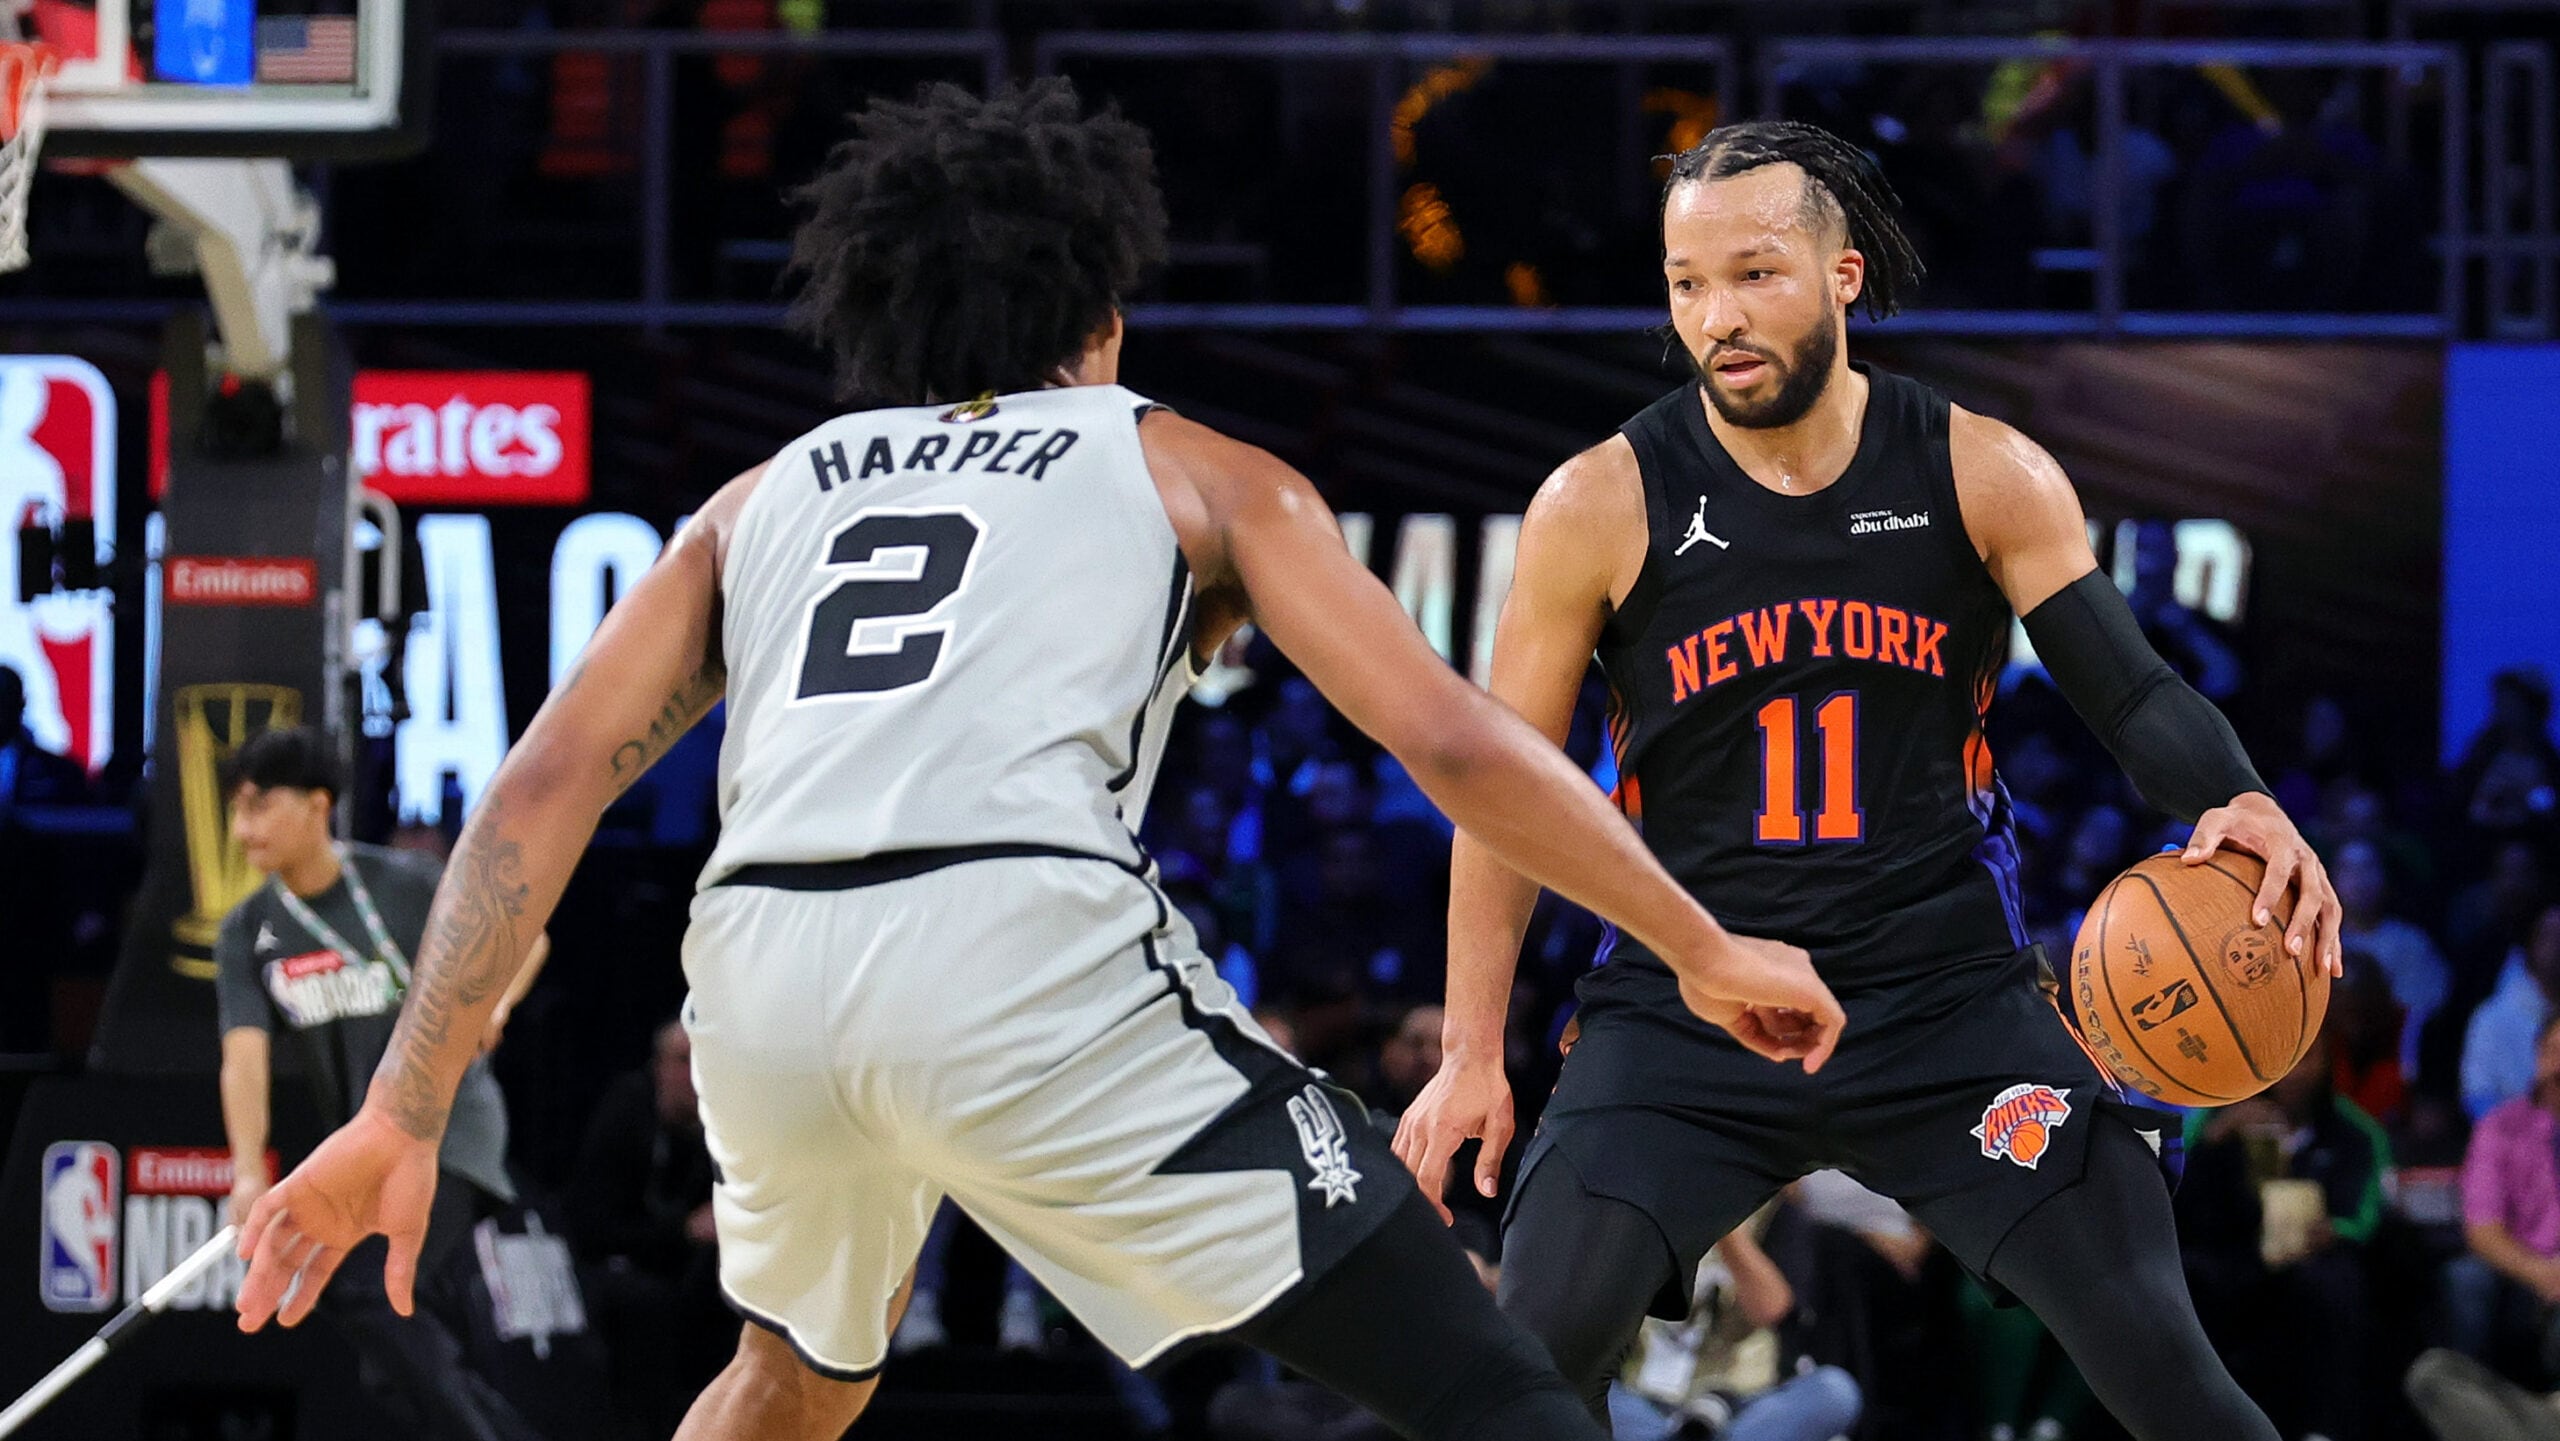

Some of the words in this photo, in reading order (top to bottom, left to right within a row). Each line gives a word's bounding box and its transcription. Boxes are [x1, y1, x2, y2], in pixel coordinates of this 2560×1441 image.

[352, 393, 563, 478] rates
[809, 428, 1080, 492] HARPER
[1850, 510, 1893, 520] experience
[1850, 519, 1882, 535] abu
[1883, 511, 1930, 531] dhabi
[785, 504, 989, 708] 2
[1667, 602, 1793, 705] NEW
[1798, 598, 1949, 679] YORK
[1753, 689, 1865, 846] 11
[1985, 1088, 2067, 1152] KNICKS
[136, 1152, 235, 1189] Emirat
